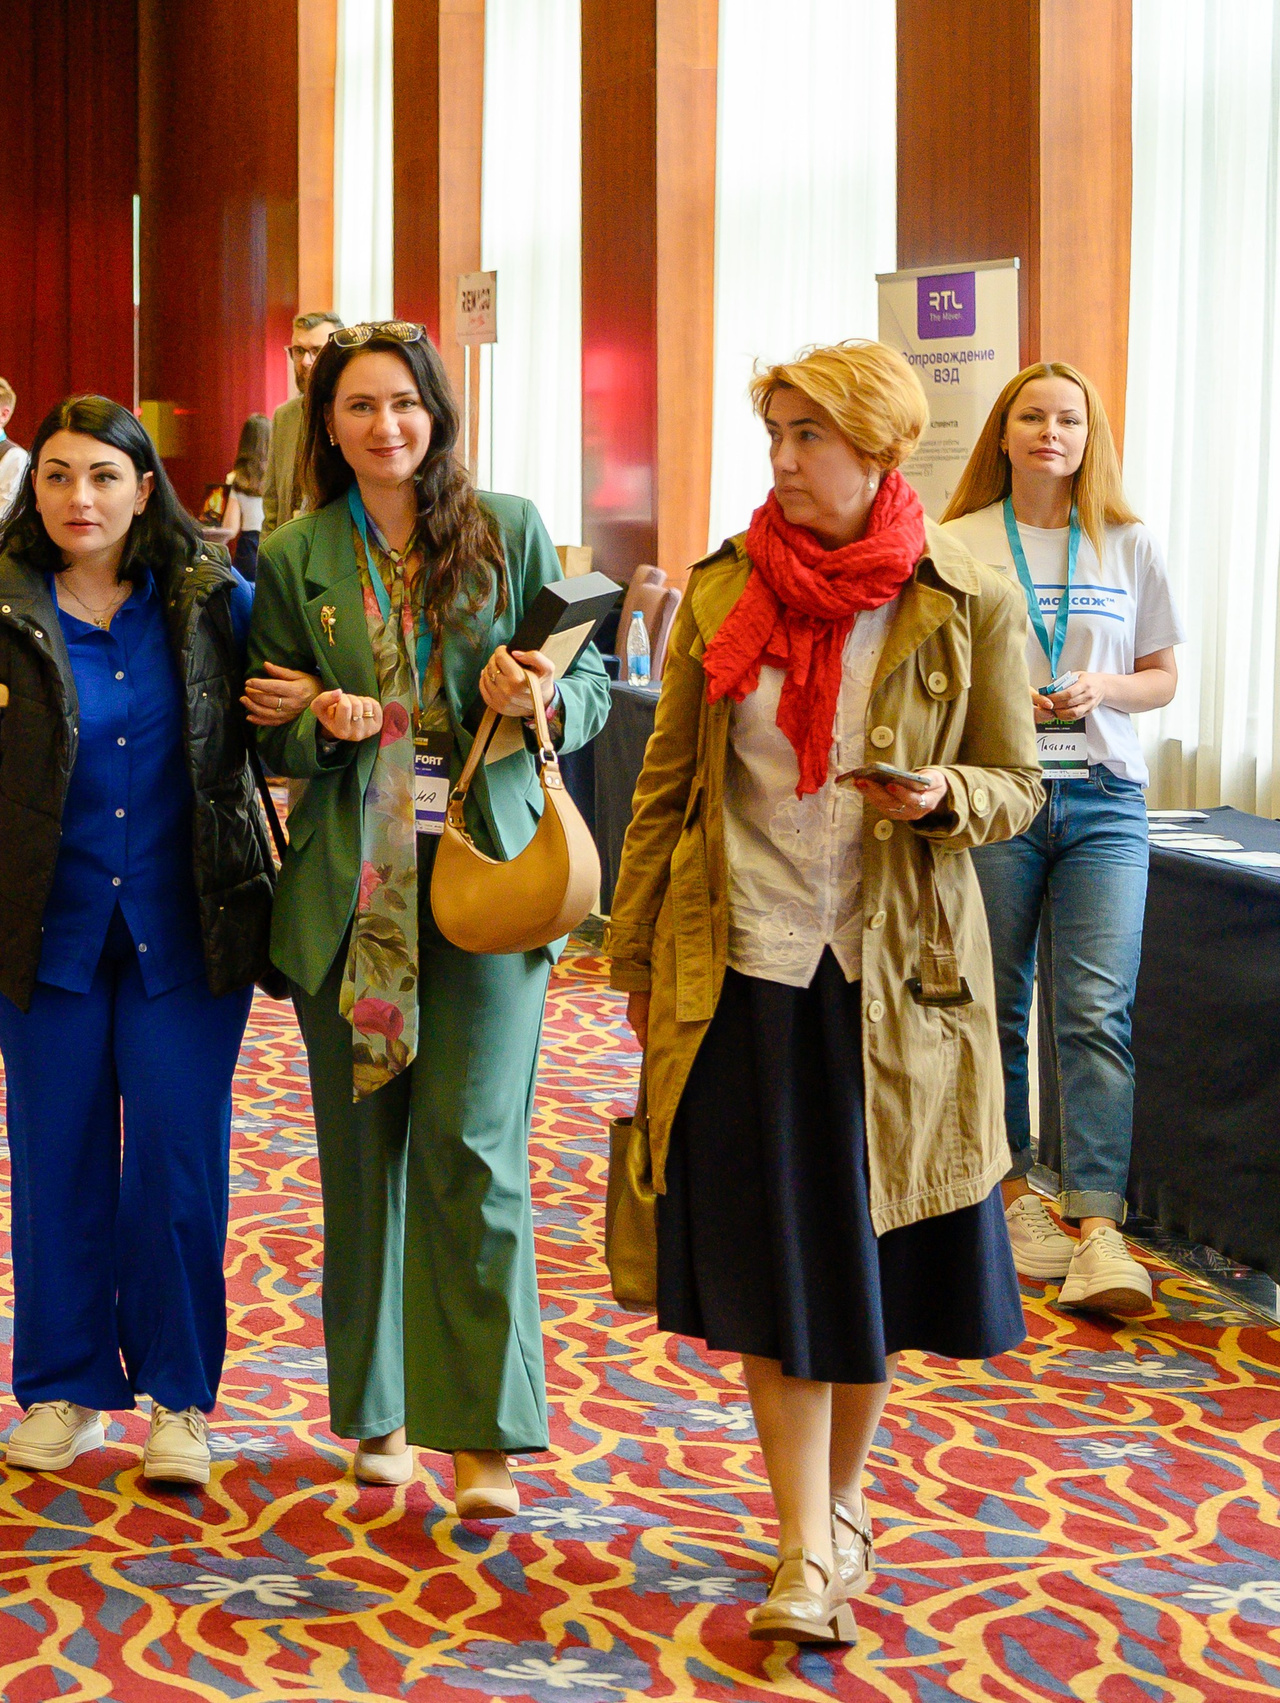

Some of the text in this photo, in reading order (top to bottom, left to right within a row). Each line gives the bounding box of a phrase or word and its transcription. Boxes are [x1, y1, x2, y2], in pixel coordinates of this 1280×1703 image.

[934, 368, 960, 384] ВЭД
[415, 754, 444, 766] FORT
[416, 790, 437, 803] НА
